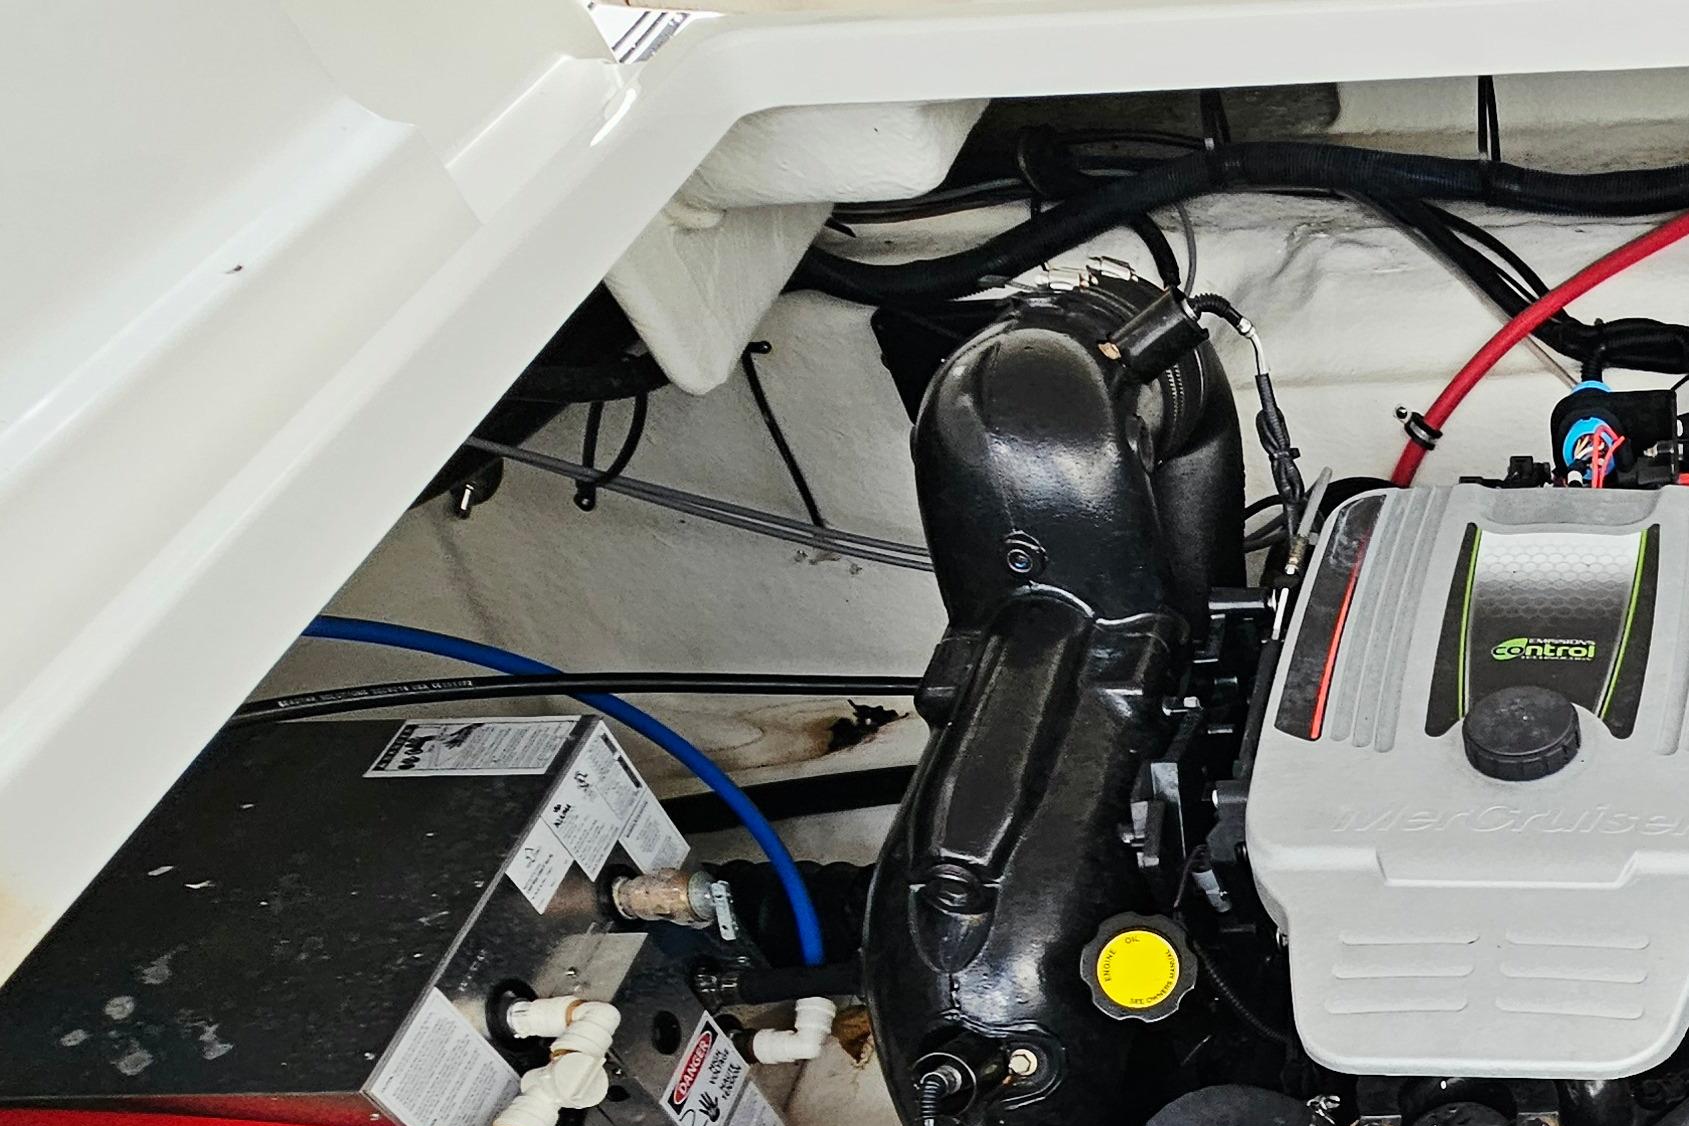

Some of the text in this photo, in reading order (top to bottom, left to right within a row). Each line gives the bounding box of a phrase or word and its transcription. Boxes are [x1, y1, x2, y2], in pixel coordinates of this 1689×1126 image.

[1492, 644, 1596, 658] control
[1103, 935, 1140, 982] ENGINE OIL
[677, 1039, 710, 1096] DANGER
